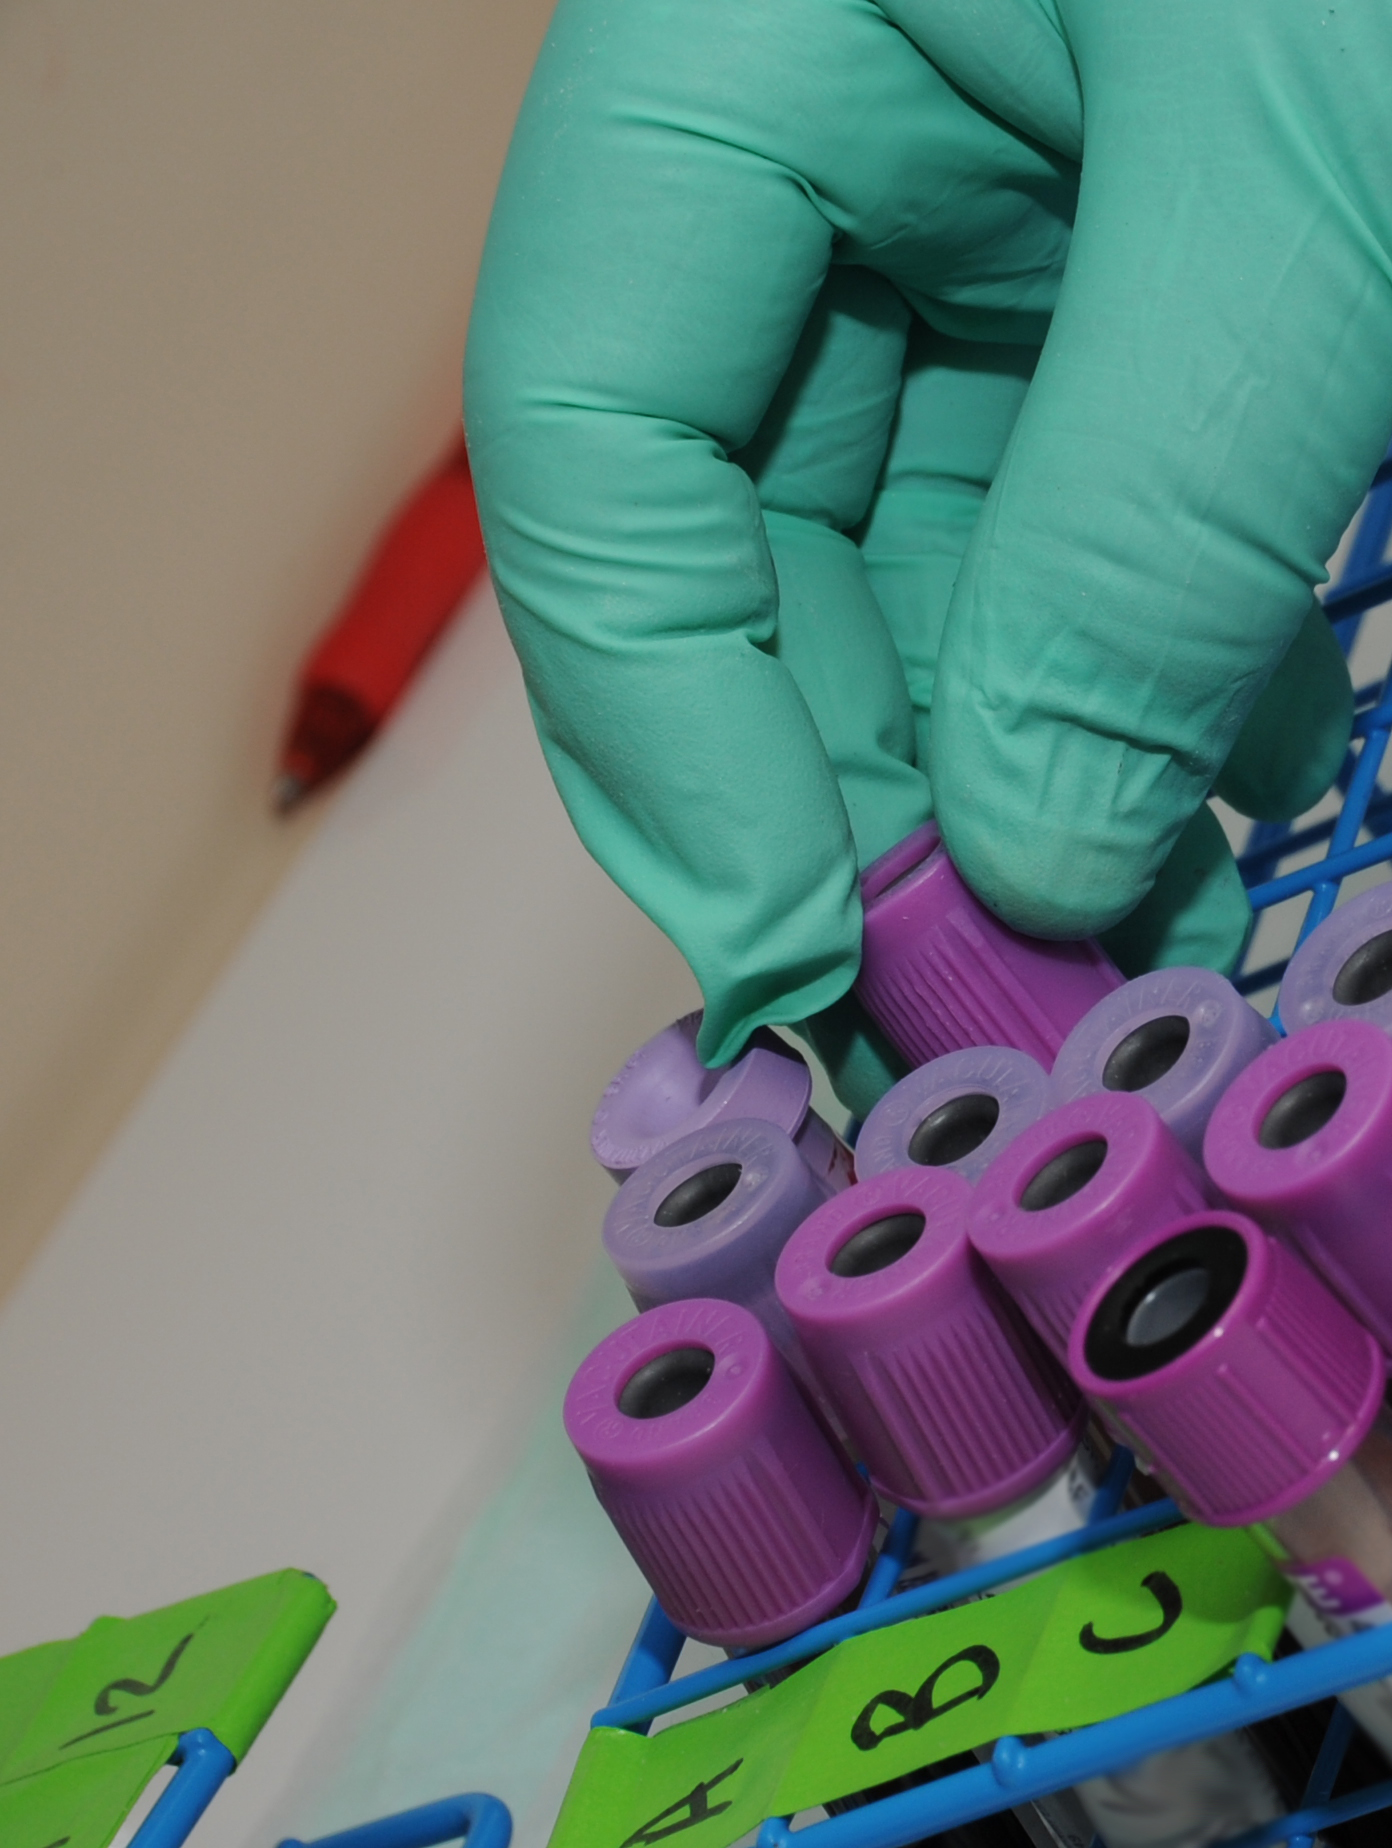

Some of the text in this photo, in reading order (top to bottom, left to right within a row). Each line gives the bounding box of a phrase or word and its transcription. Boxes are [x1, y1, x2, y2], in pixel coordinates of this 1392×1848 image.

[619, 1757, 744, 1848] A
[850, 1644, 1000, 1752] B
[1078, 1570, 1184, 1655] C
